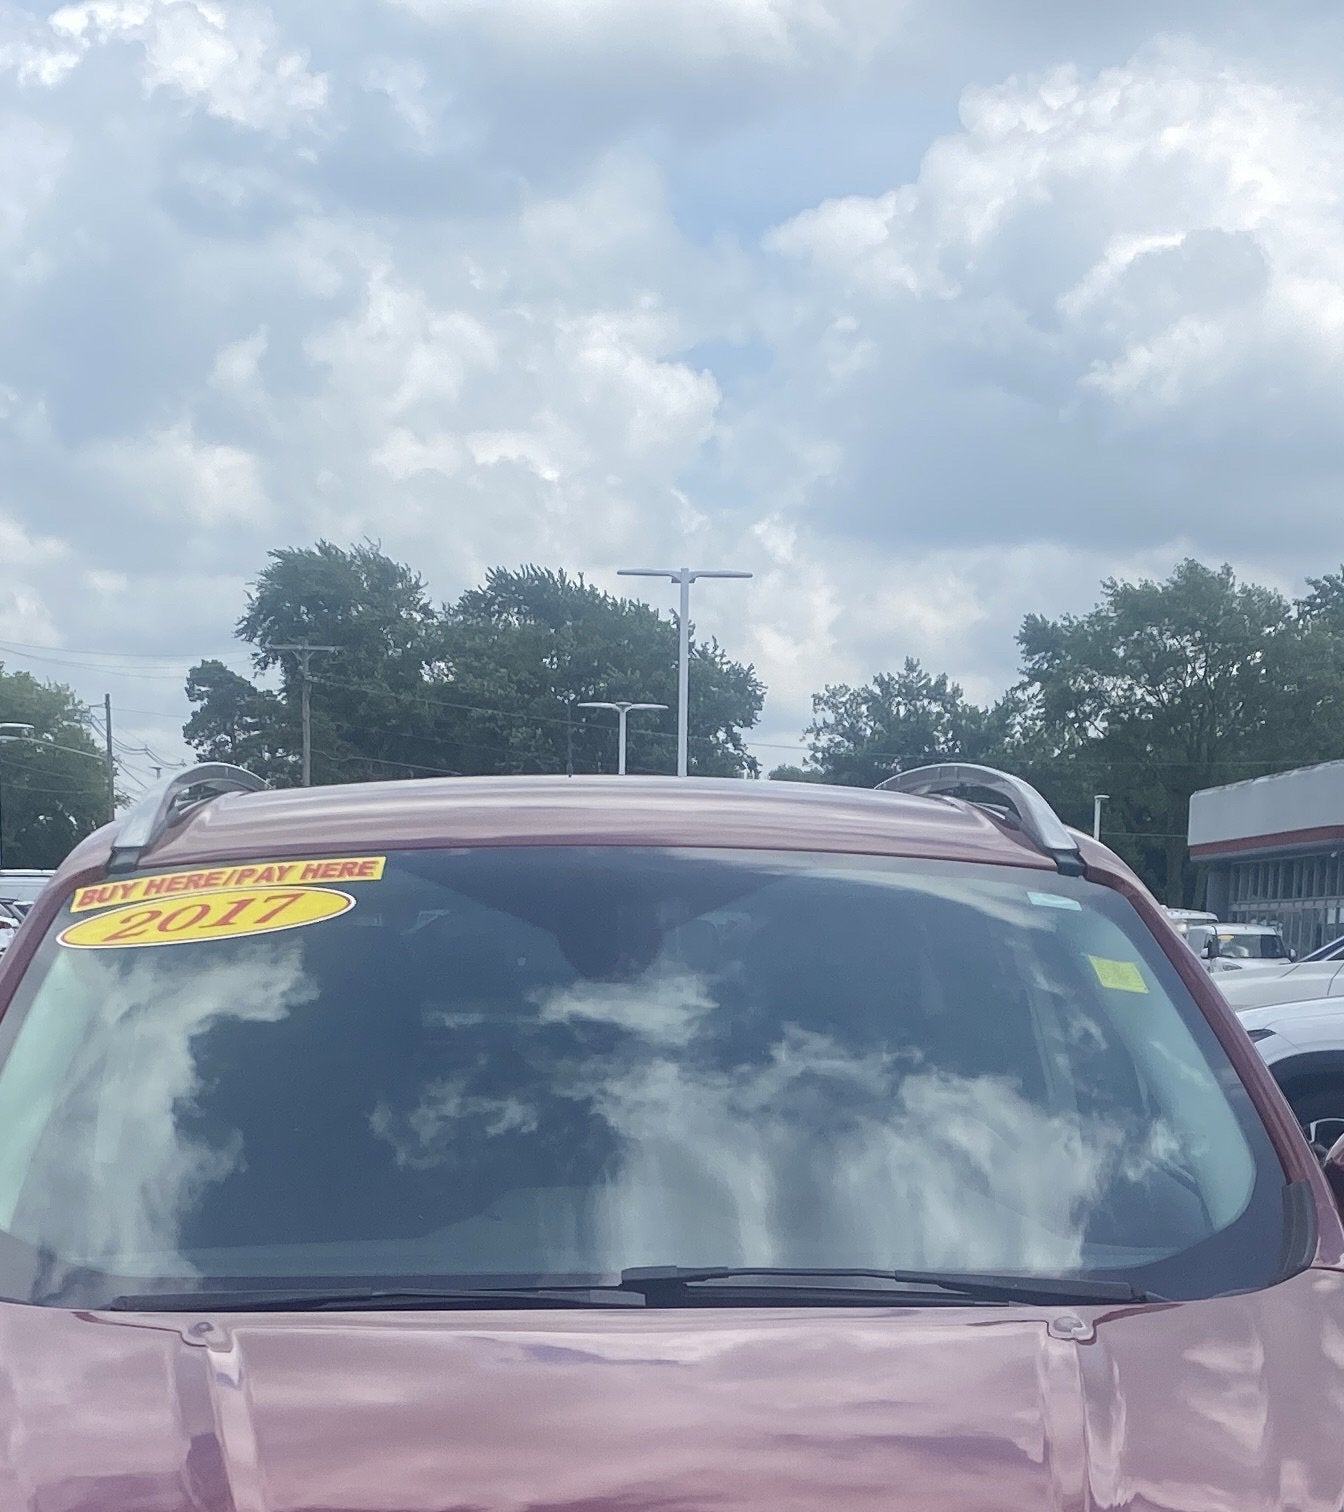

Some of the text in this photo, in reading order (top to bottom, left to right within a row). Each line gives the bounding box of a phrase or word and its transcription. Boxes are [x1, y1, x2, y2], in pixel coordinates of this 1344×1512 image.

[76, 860, 379, 906] BUY HERE/PAY HERE
[102, 892, 307, 942] 2017
